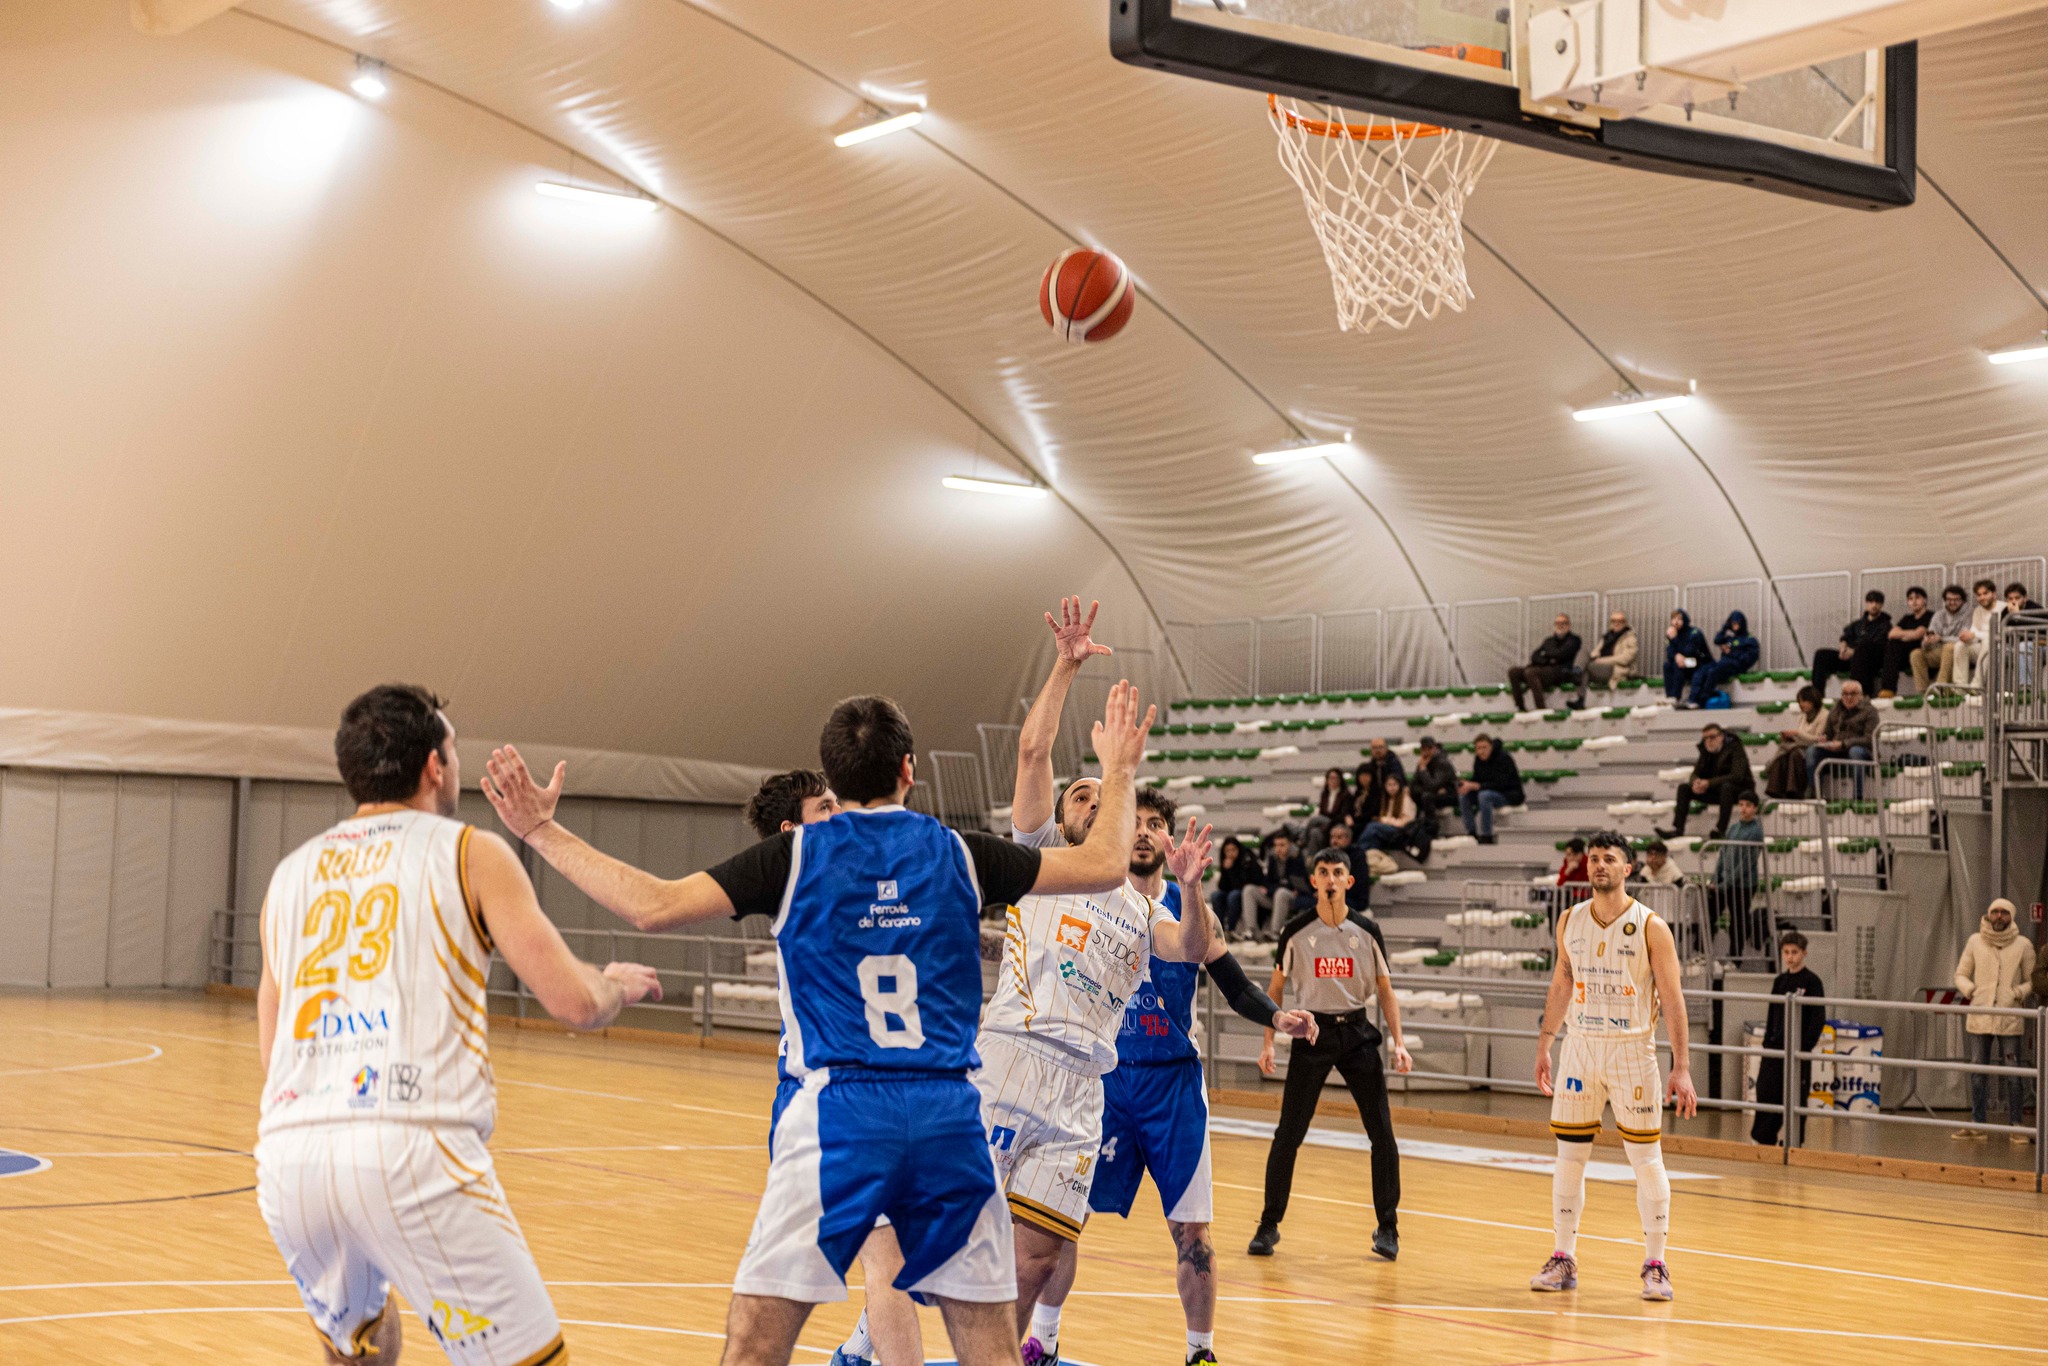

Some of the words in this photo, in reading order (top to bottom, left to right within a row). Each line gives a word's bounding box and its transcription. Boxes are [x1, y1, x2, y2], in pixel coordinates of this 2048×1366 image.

[313, 840, 393, 884] ROLLO
[858, 915, 874, 928] del
[878, 915, 921, 928] Gargano
[1086, 900, 1113, 922] Fresh
[294, 882, 399, 988] 23
[1319, 958, 1350, 968] ATTAL
[1319, 967, 1350, 975] GROUP
[1586, 982, 1636, 996] STUDIO3A
[857, 954, 926, 1049] 8
[323, 1008, 389, 1038] DANA
[297, 1036, 389, 1058] COSTRUZIONI
[1634, 1085, 1643, 1101] 0
[1075, 1154, 1092, 1177] 10
[433, 1299, 492, 1339] 23
